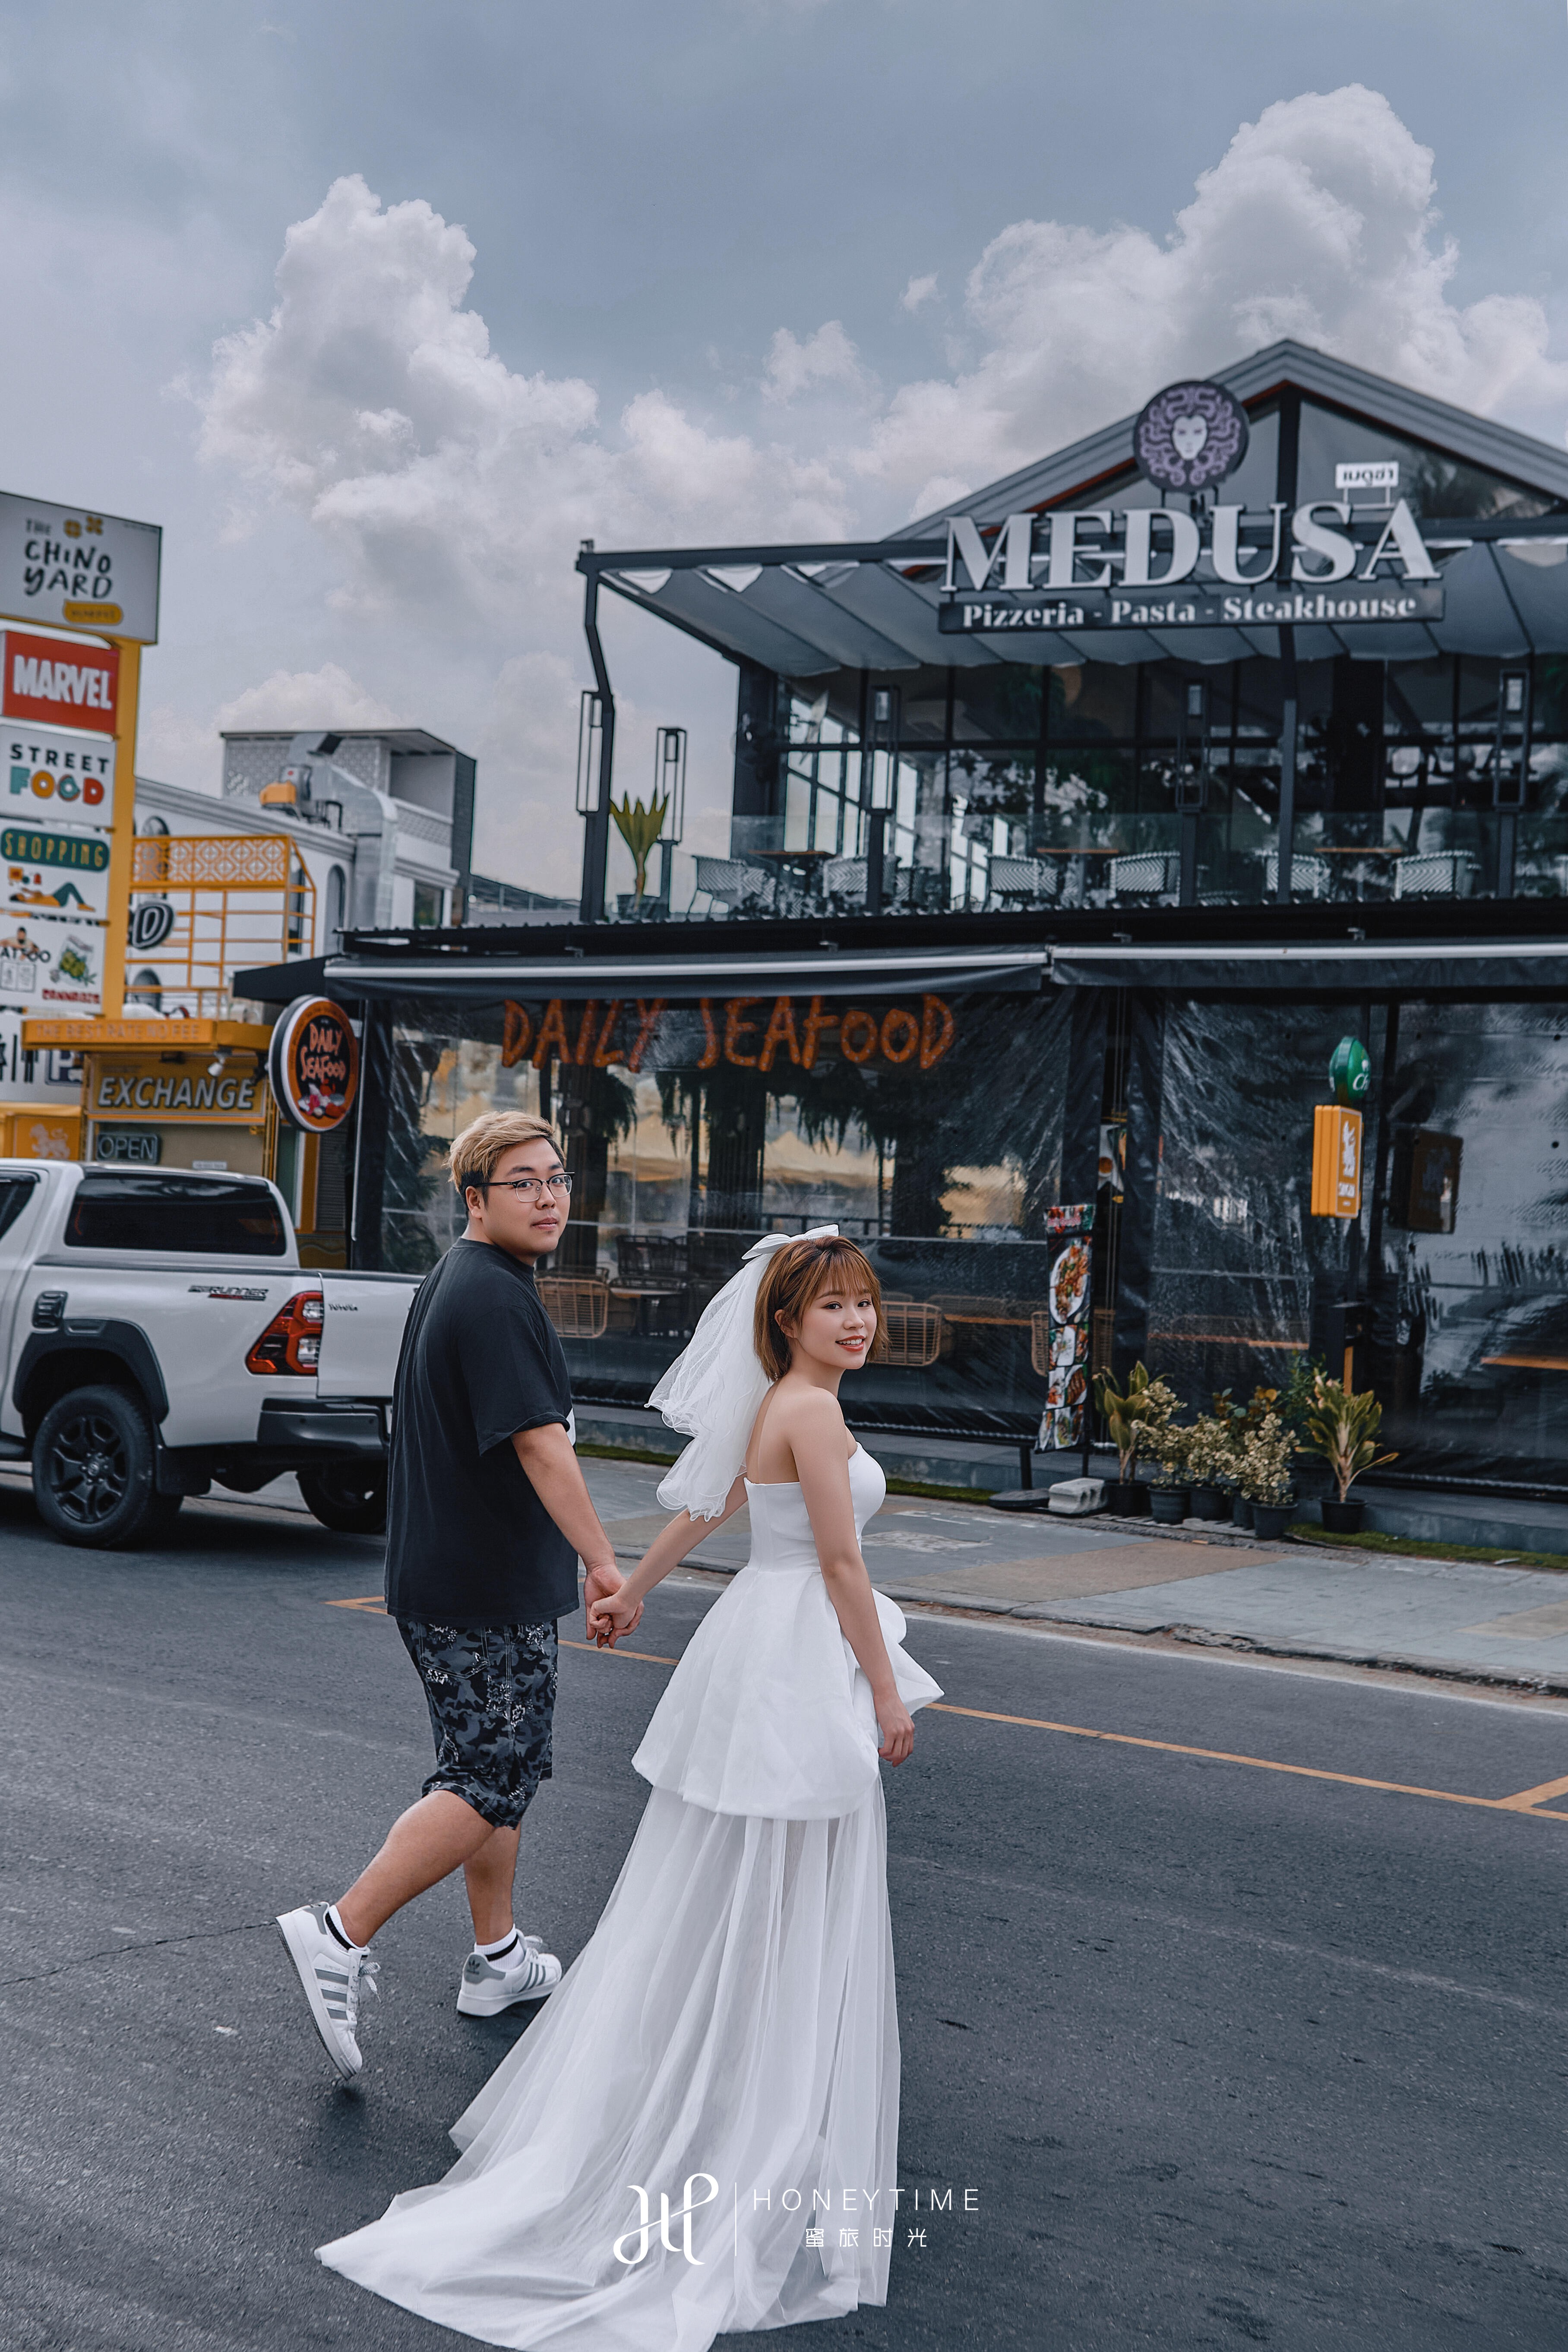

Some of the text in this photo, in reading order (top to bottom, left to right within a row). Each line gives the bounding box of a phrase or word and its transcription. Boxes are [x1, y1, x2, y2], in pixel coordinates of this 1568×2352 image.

[25, 540, 111, 574] CHINO
[940, 499, 1442, 591] MEDUSA
[25, 566, 113, 599] YARD
[963, 594, 1416, 627] Pizzeria Pasta Steakhouse
[13, 654, 113, 710] MARVEL
[10, 743, 110, 774] STREET
[9, 766, 104, 806] FOOD
[5, 832, 104, 868] SHOPPING
[37, 1023, 61, 1038] THE
[66, 1023, 103, 1039] BEST
[107, 1024, 143, 1039] RATE
[172, 1024, 199, 1039] FEE
[310, 1023, 342, 1056] DAILY
[501, 994, 955, 1074] DAILY SEAFOOD
[300, 1046, 346, 1084] SEAFOOD
[98, 1077, 255, 1110] EXCHANGE
[98, 1136, 155, 1160] OPEN
